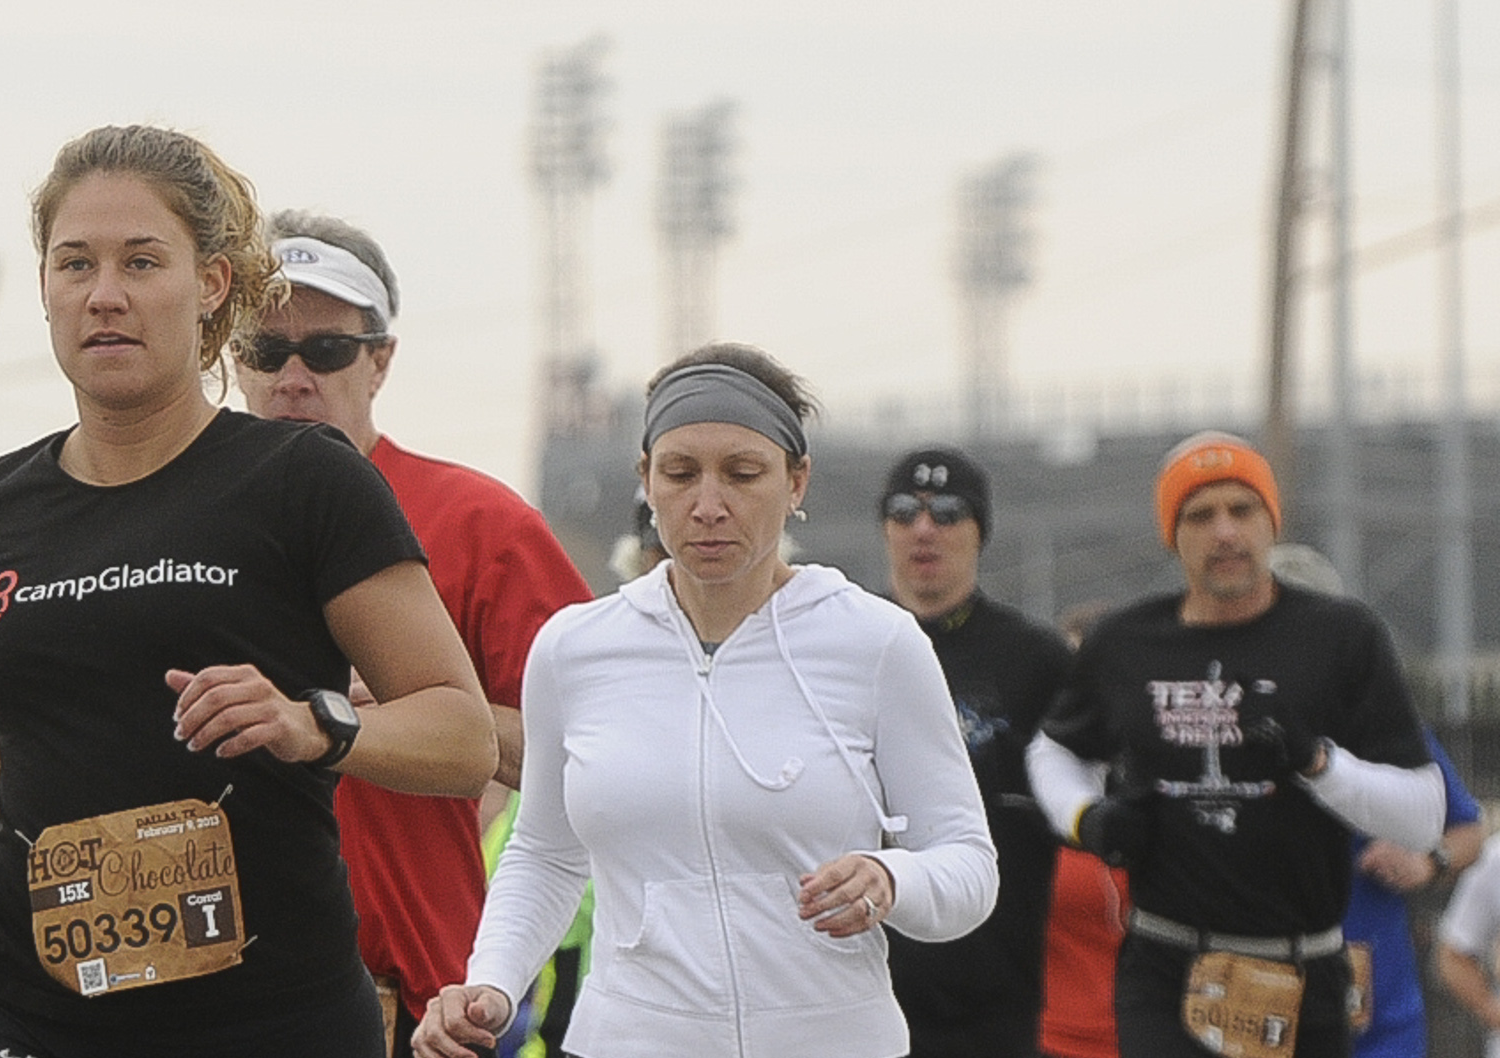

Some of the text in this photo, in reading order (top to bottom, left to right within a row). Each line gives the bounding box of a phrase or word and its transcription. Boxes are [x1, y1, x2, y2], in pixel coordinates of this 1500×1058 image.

[14, 558, 239, 602] campGladiator
[135, 823, 185, 840] February
[29, 838, 102, 884] HOT
[99, 838, 237, 898] Chocolate
[58, 881, 90, 904] 15K
[186, 891, 223, 905] Corral
[44, 903, 178, 964] 50339
[202, 904, 219, 938] I
